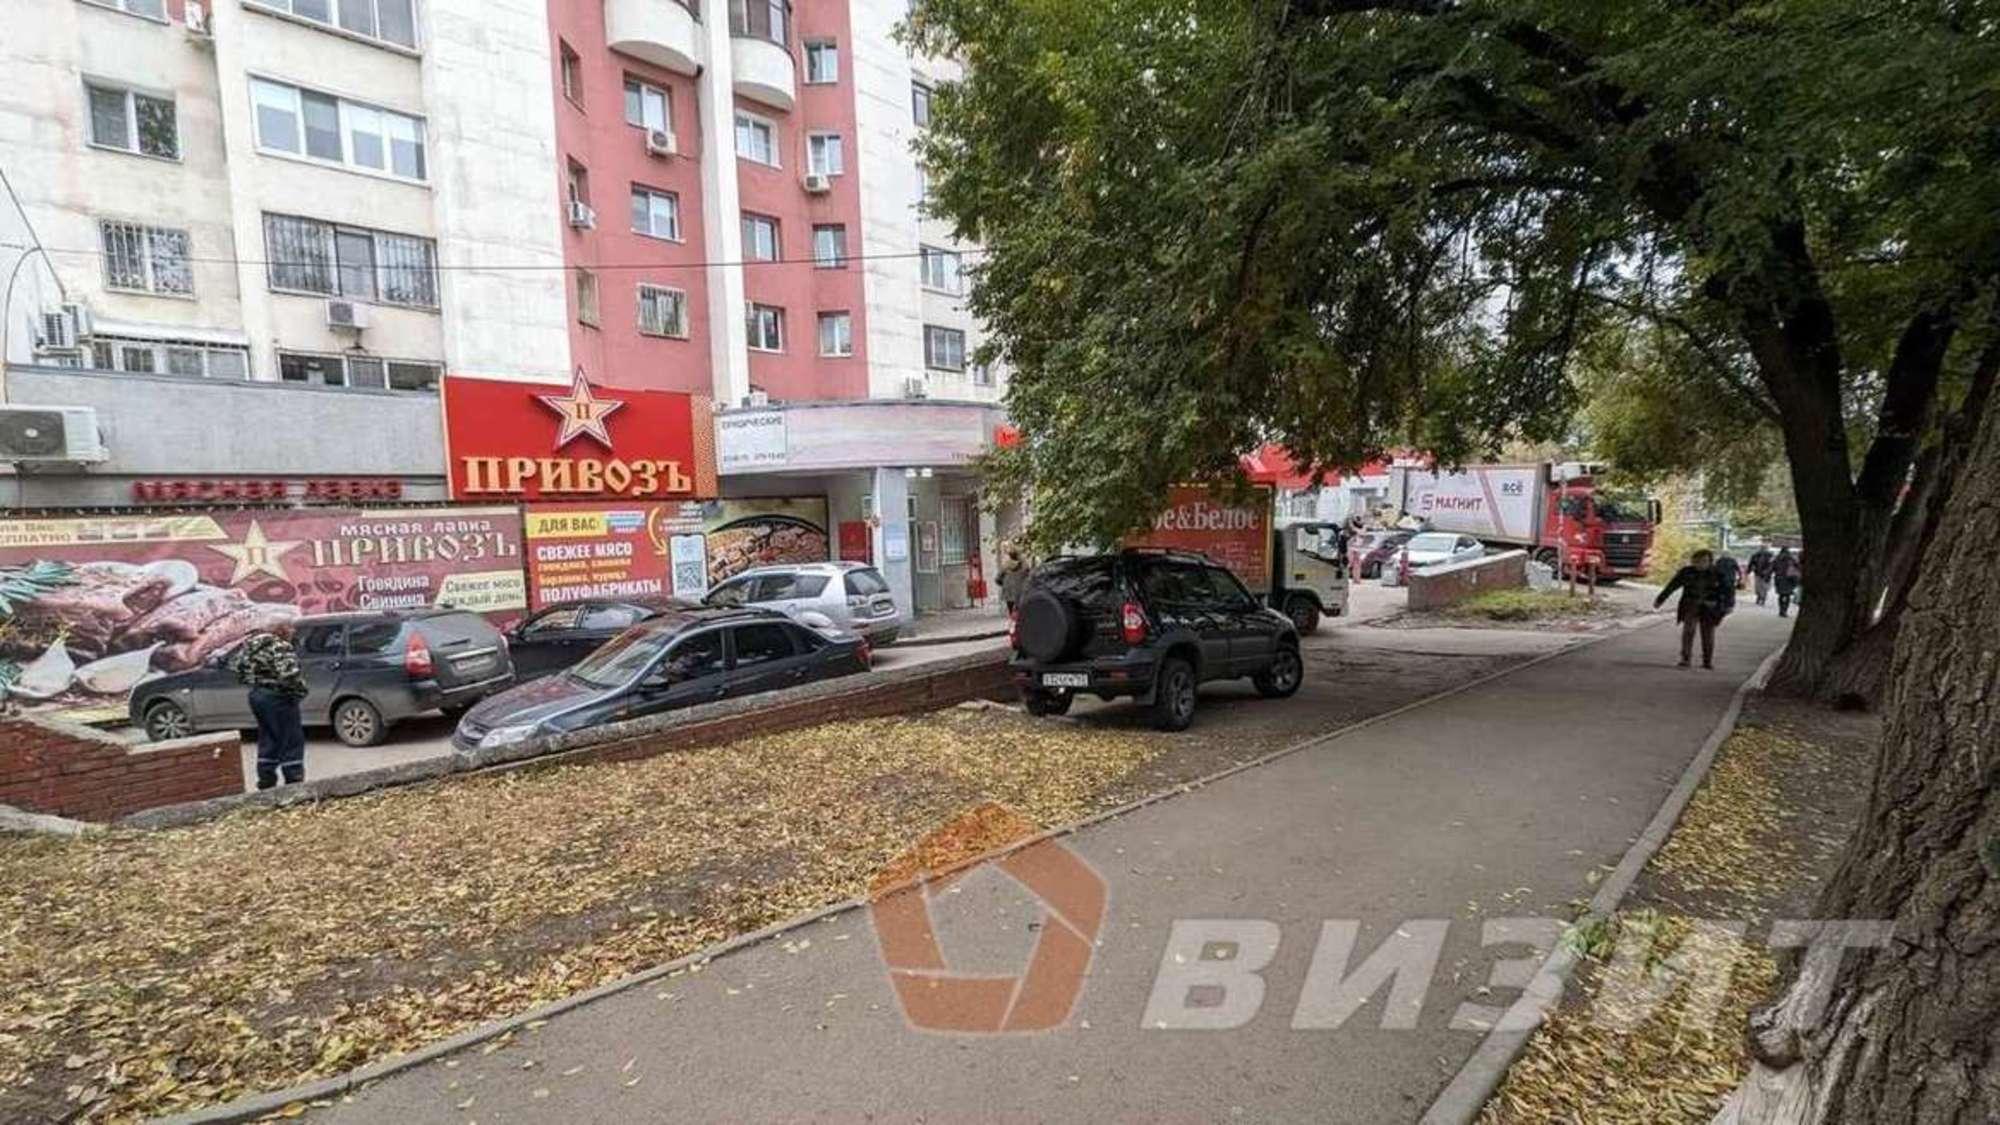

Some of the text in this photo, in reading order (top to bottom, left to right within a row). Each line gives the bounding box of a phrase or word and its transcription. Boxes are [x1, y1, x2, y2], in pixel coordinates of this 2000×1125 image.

[461, 456, 692, 496] ПРИВОЗЪ
[1435, 497, 1483, 511] МАГНИТ
[538, 519, 568, 533] ДЛЯ
[310, 532, 517, 567] ПРИВОЗЪ
[537, 542, 633, 560] СВЕЖЕЕ МЯСО
[358, 575, 430, 592] Говядина
[540, 579, 662, 602] ПОЛУФАБРИКАТЫ
